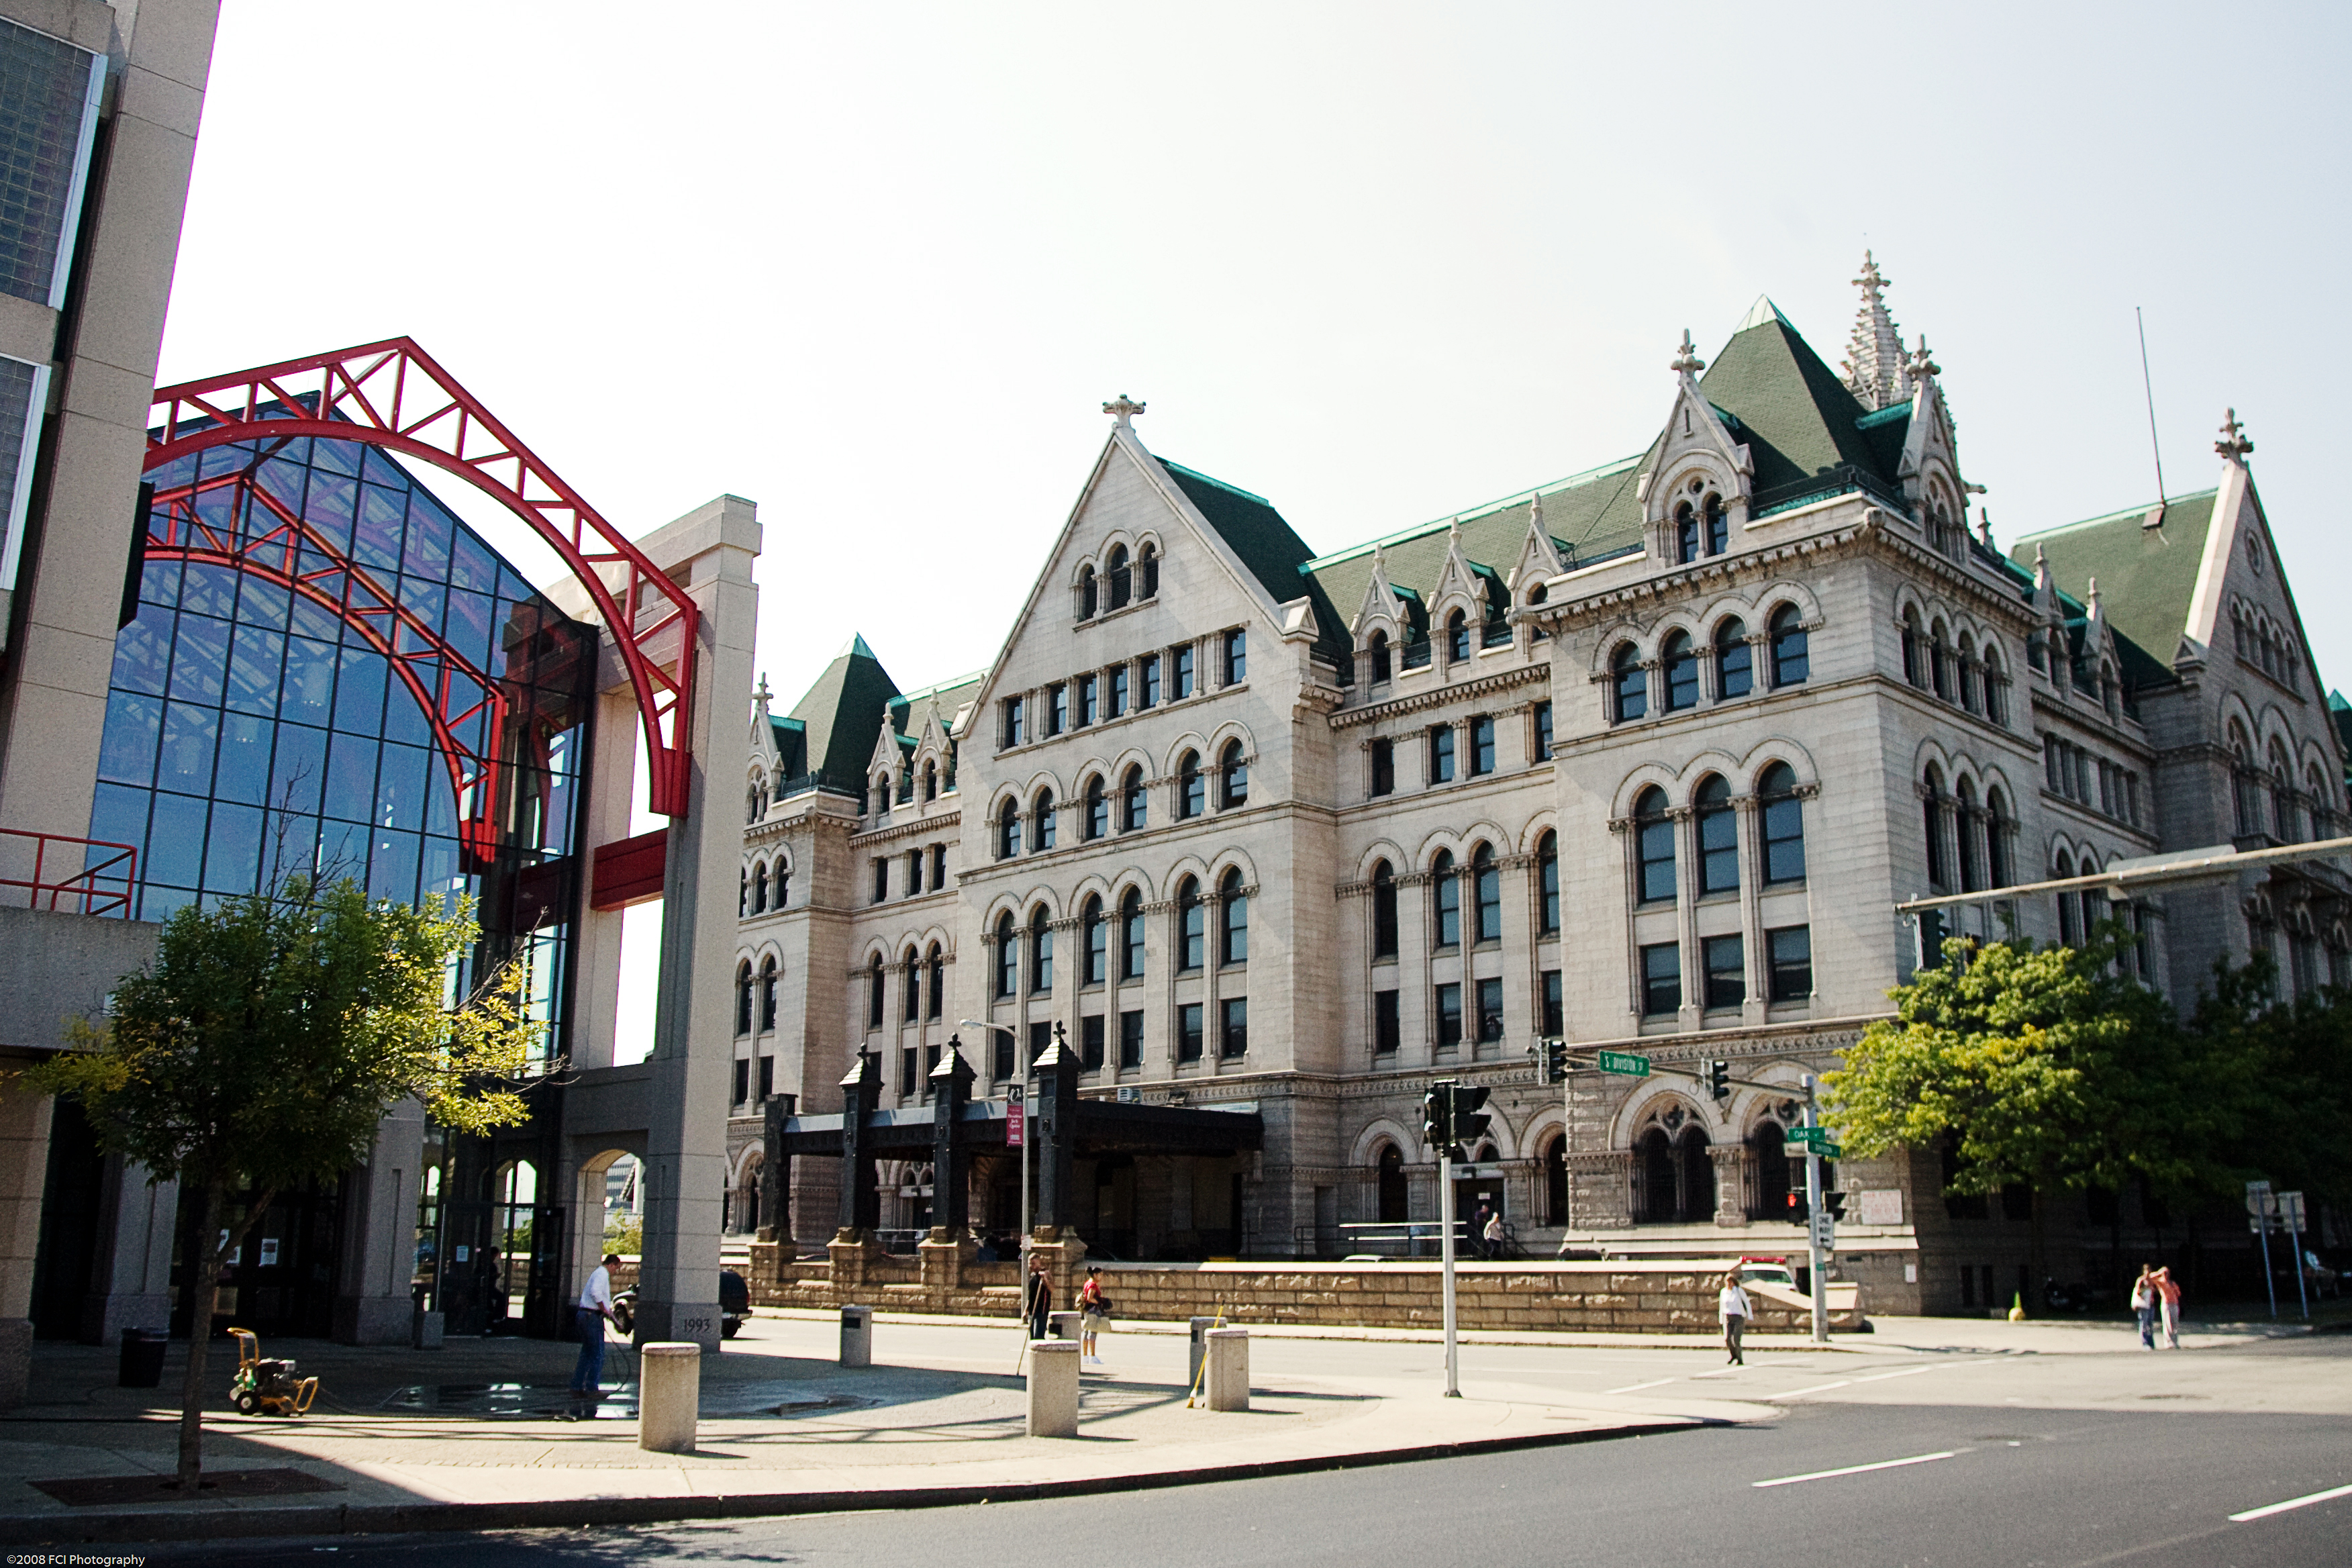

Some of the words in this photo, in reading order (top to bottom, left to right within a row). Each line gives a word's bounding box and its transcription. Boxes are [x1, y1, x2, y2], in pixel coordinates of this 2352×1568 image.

[1605, 1056, 1610, 1068] S
[1614, 1057, 1636, 1072] DIVISION
[1794, 1130, 1810, 1138] OAK
[1819, 1226, 1831, 1234] WAY
[684, 1318, 710, 1332] 1993
